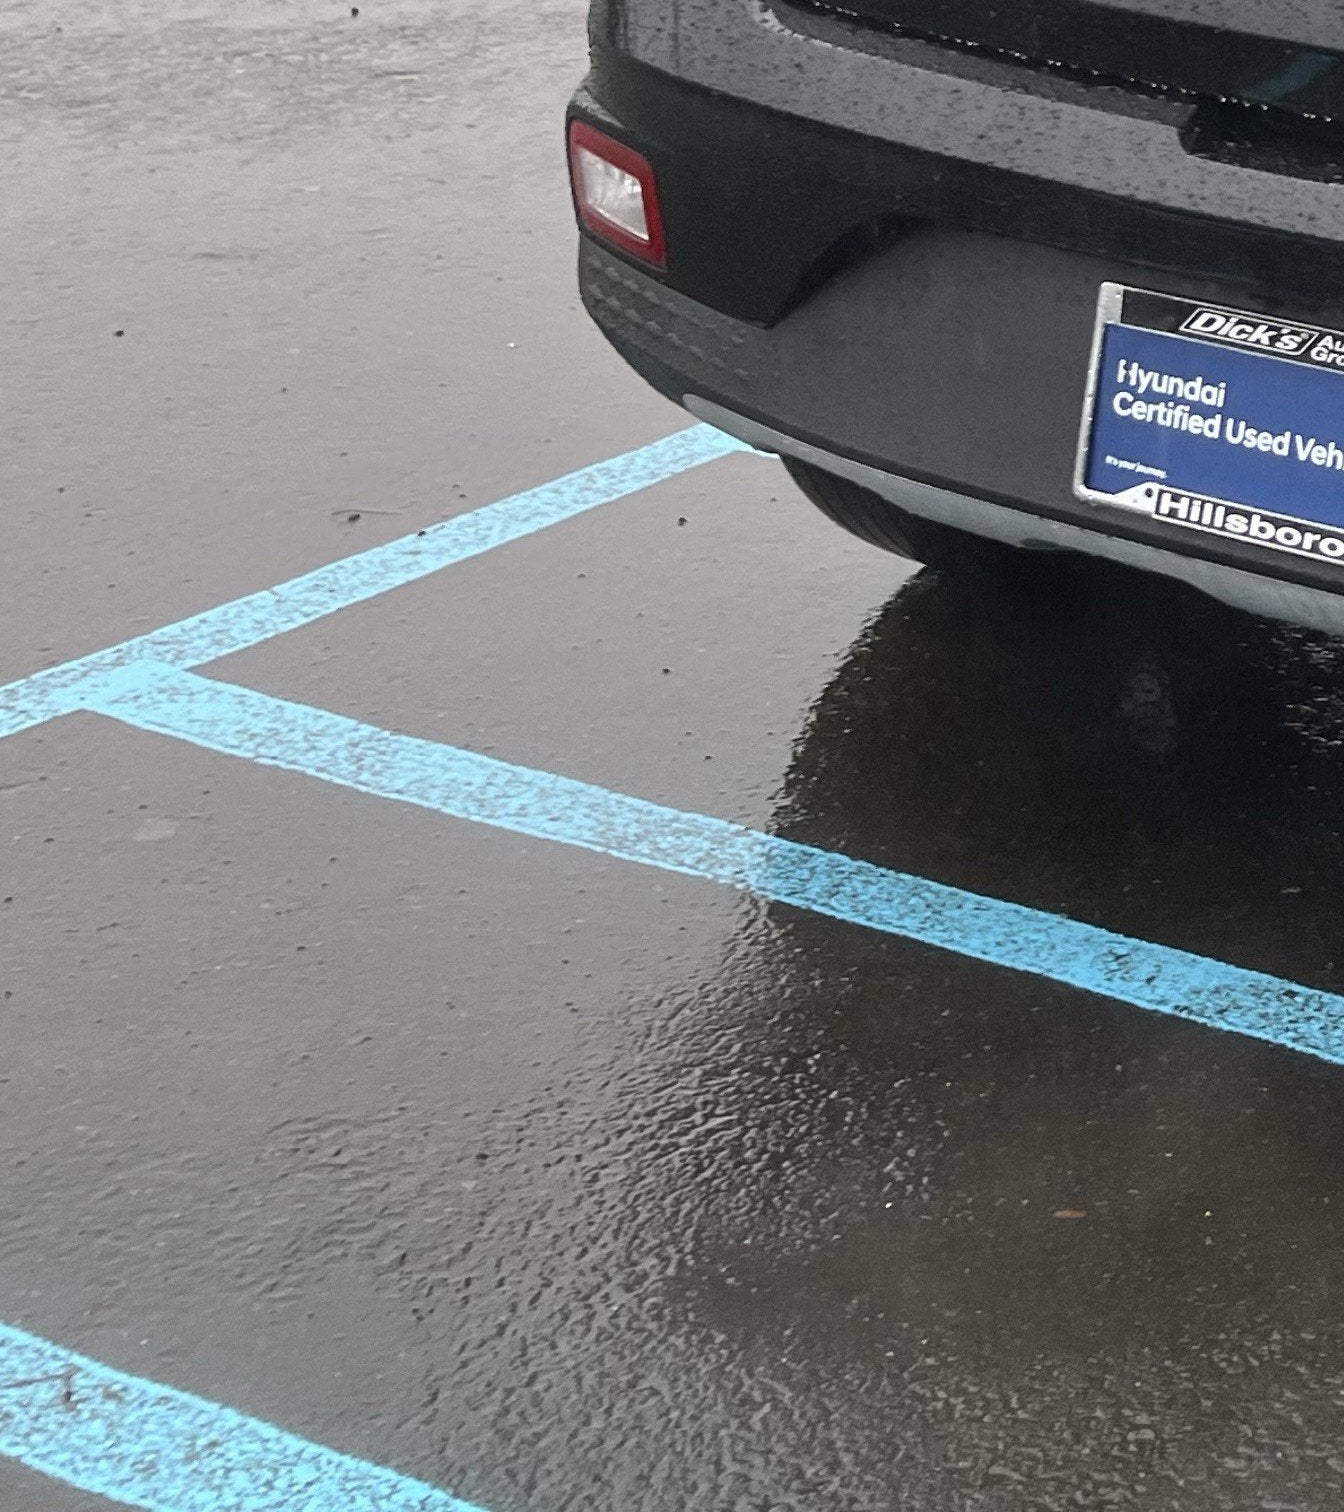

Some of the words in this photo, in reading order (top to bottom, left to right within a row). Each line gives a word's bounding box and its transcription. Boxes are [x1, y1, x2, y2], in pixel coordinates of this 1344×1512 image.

[1188, 312, 1303, 351] Dick's
[1116, 358, 1226, 408] Hyundai
[1112, 391, 1222, 439] Certified
[1225, 417, 1292, 457] Used
